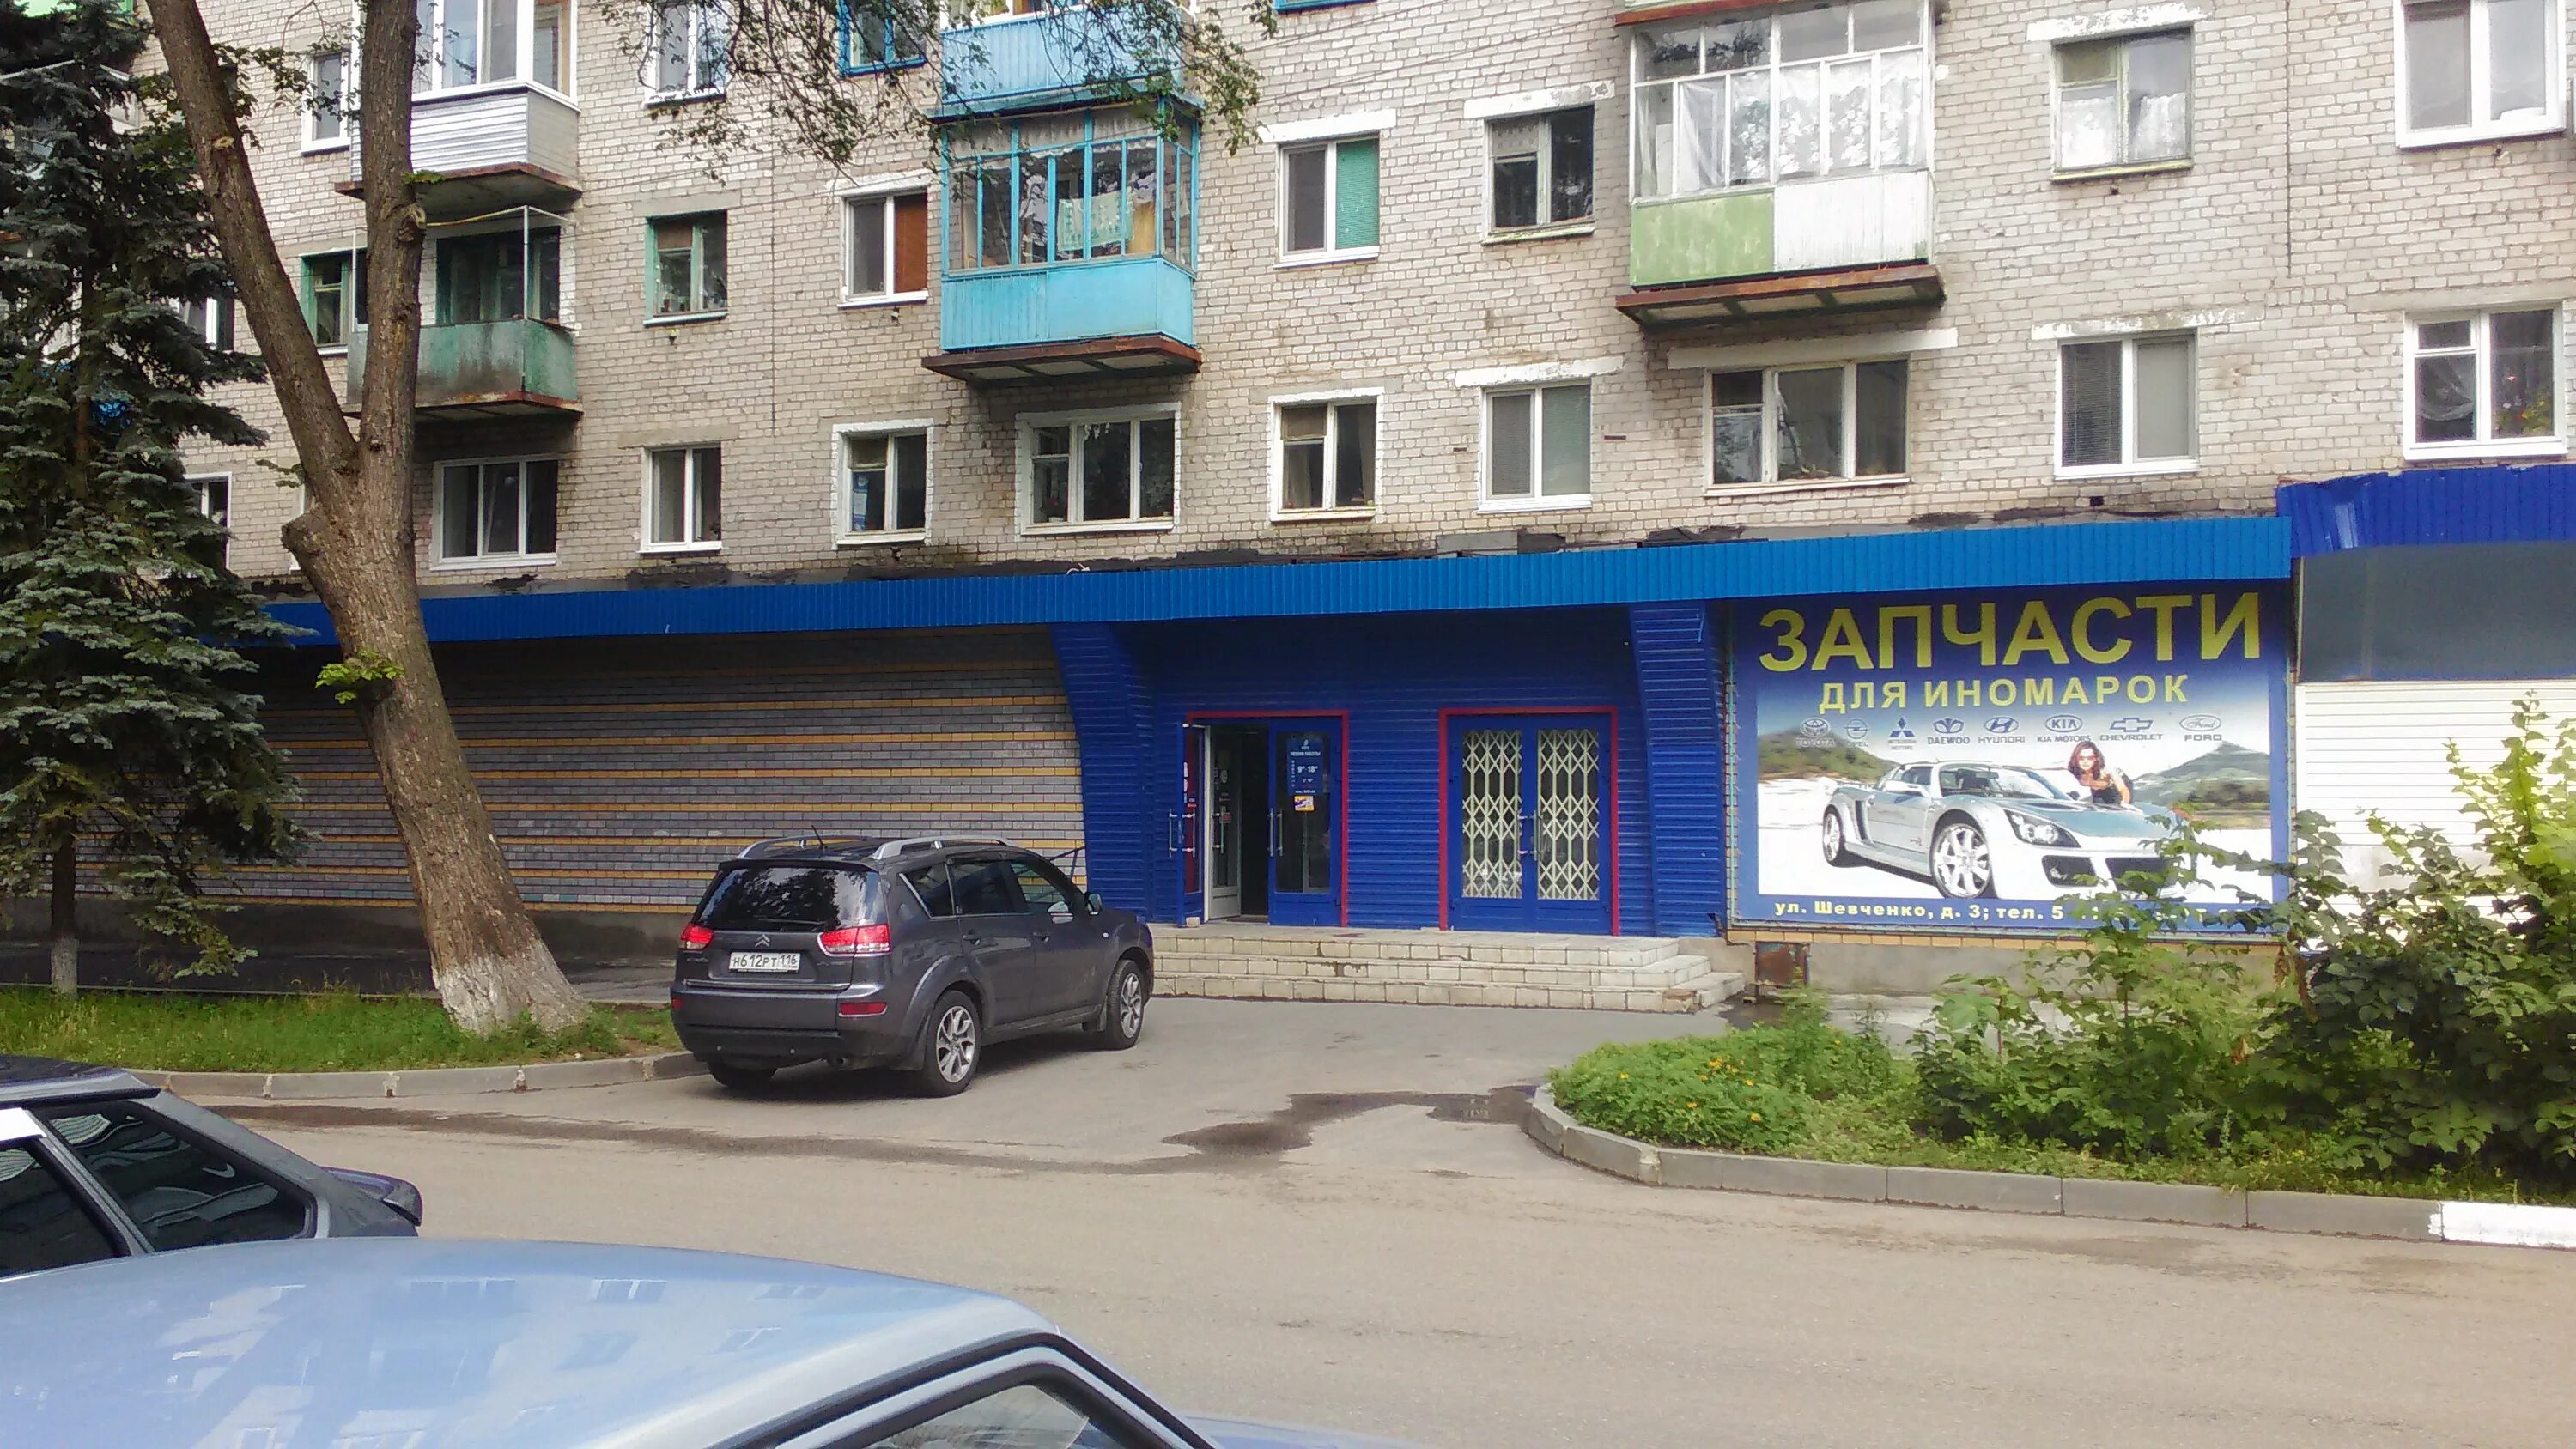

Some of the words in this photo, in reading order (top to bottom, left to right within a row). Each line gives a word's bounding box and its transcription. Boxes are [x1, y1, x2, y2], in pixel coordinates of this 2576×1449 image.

[1758, 592, 2262, 672] ЗАПЧАСТИ
[1819, 682, 1907, 714] ДЛЯ
[1924, 675, 2189, 708] ИНОМАРОК
[2050, 718, 2077, 729] KIA
[1927, 737, 1971, 745] DAEWOO
[1775, 902, 1807, 916] ул.
[1814, 901, 1934, 919] Шевченко,
[1941, 906, 1961, 919] д.
[1968, 905, 1989, 920] 3;
[1996, 906, 2044, 919] тел.
[732, 955, 777, 967] Н612РТ
[780, 954, 797, 965] 116
